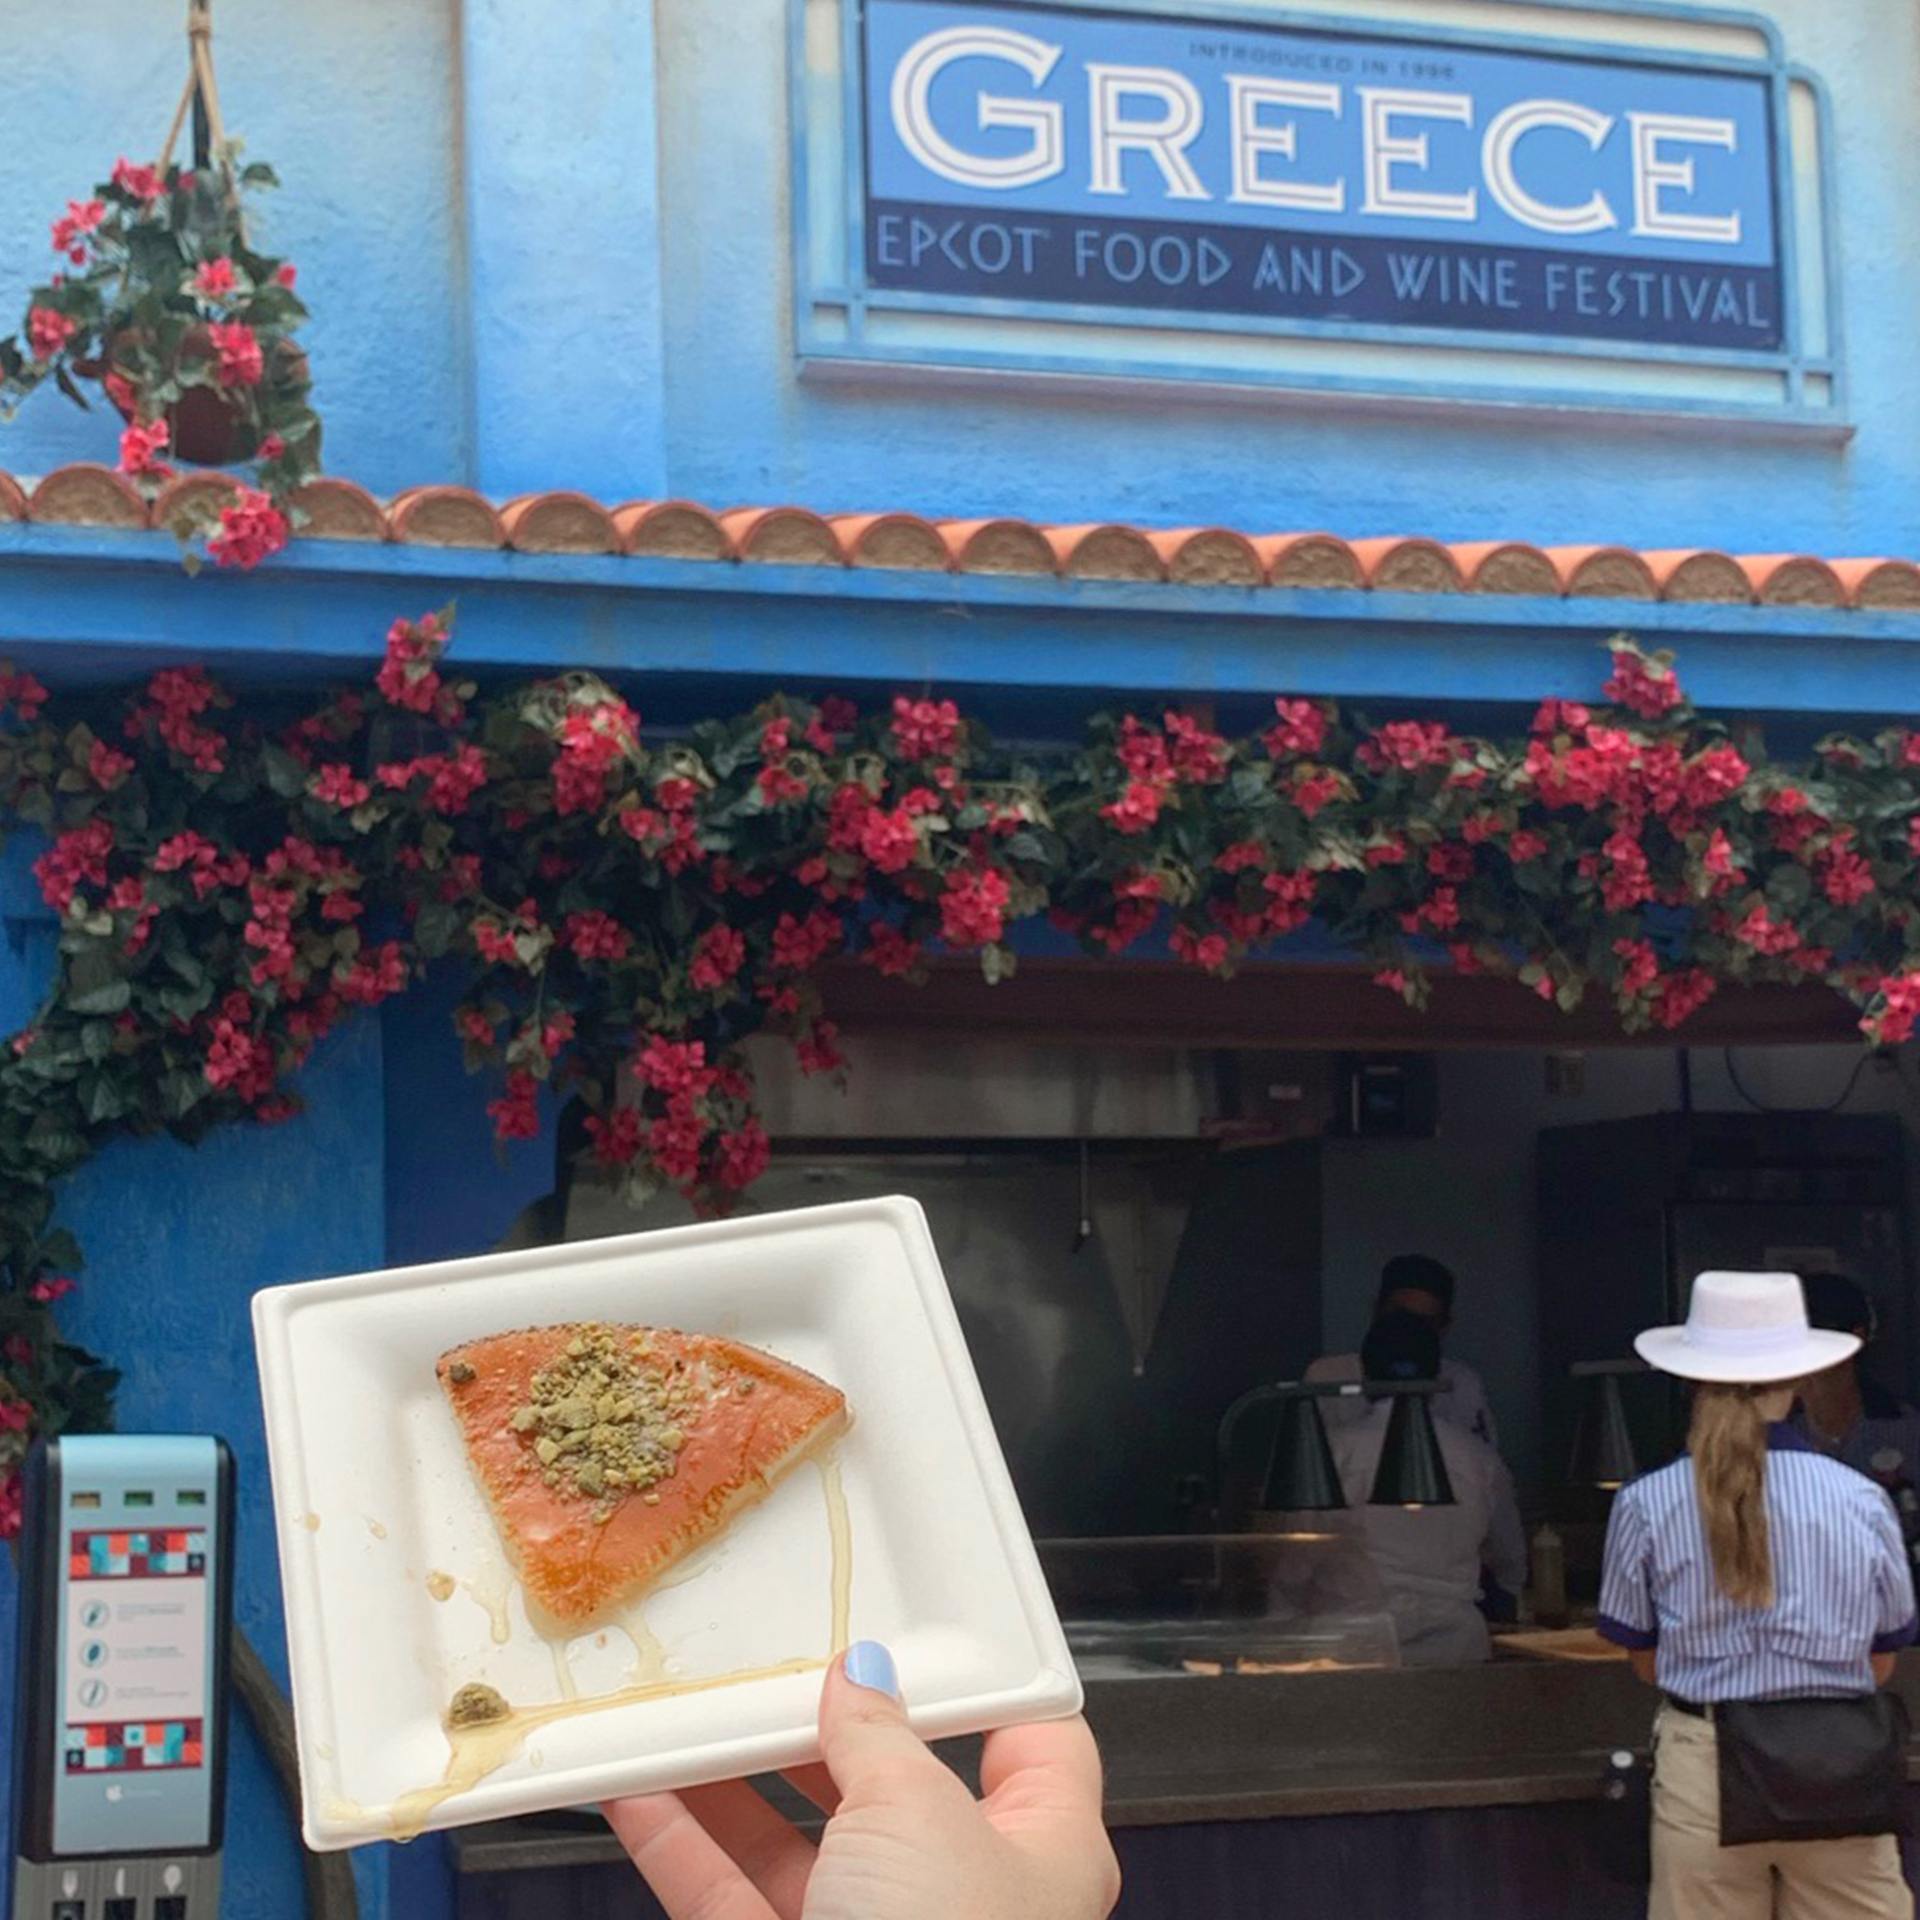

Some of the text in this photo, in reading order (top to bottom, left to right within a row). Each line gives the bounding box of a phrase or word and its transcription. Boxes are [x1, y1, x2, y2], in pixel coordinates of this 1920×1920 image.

[1188, 43, 1352, 74] INTRODUCED
[1361, 58, 1388, 75] IN
[891, 26, 1740, 243] GREECE
[876, 214, 1769, 328] EPCOT FOOD AND WINE FESTIVAL
